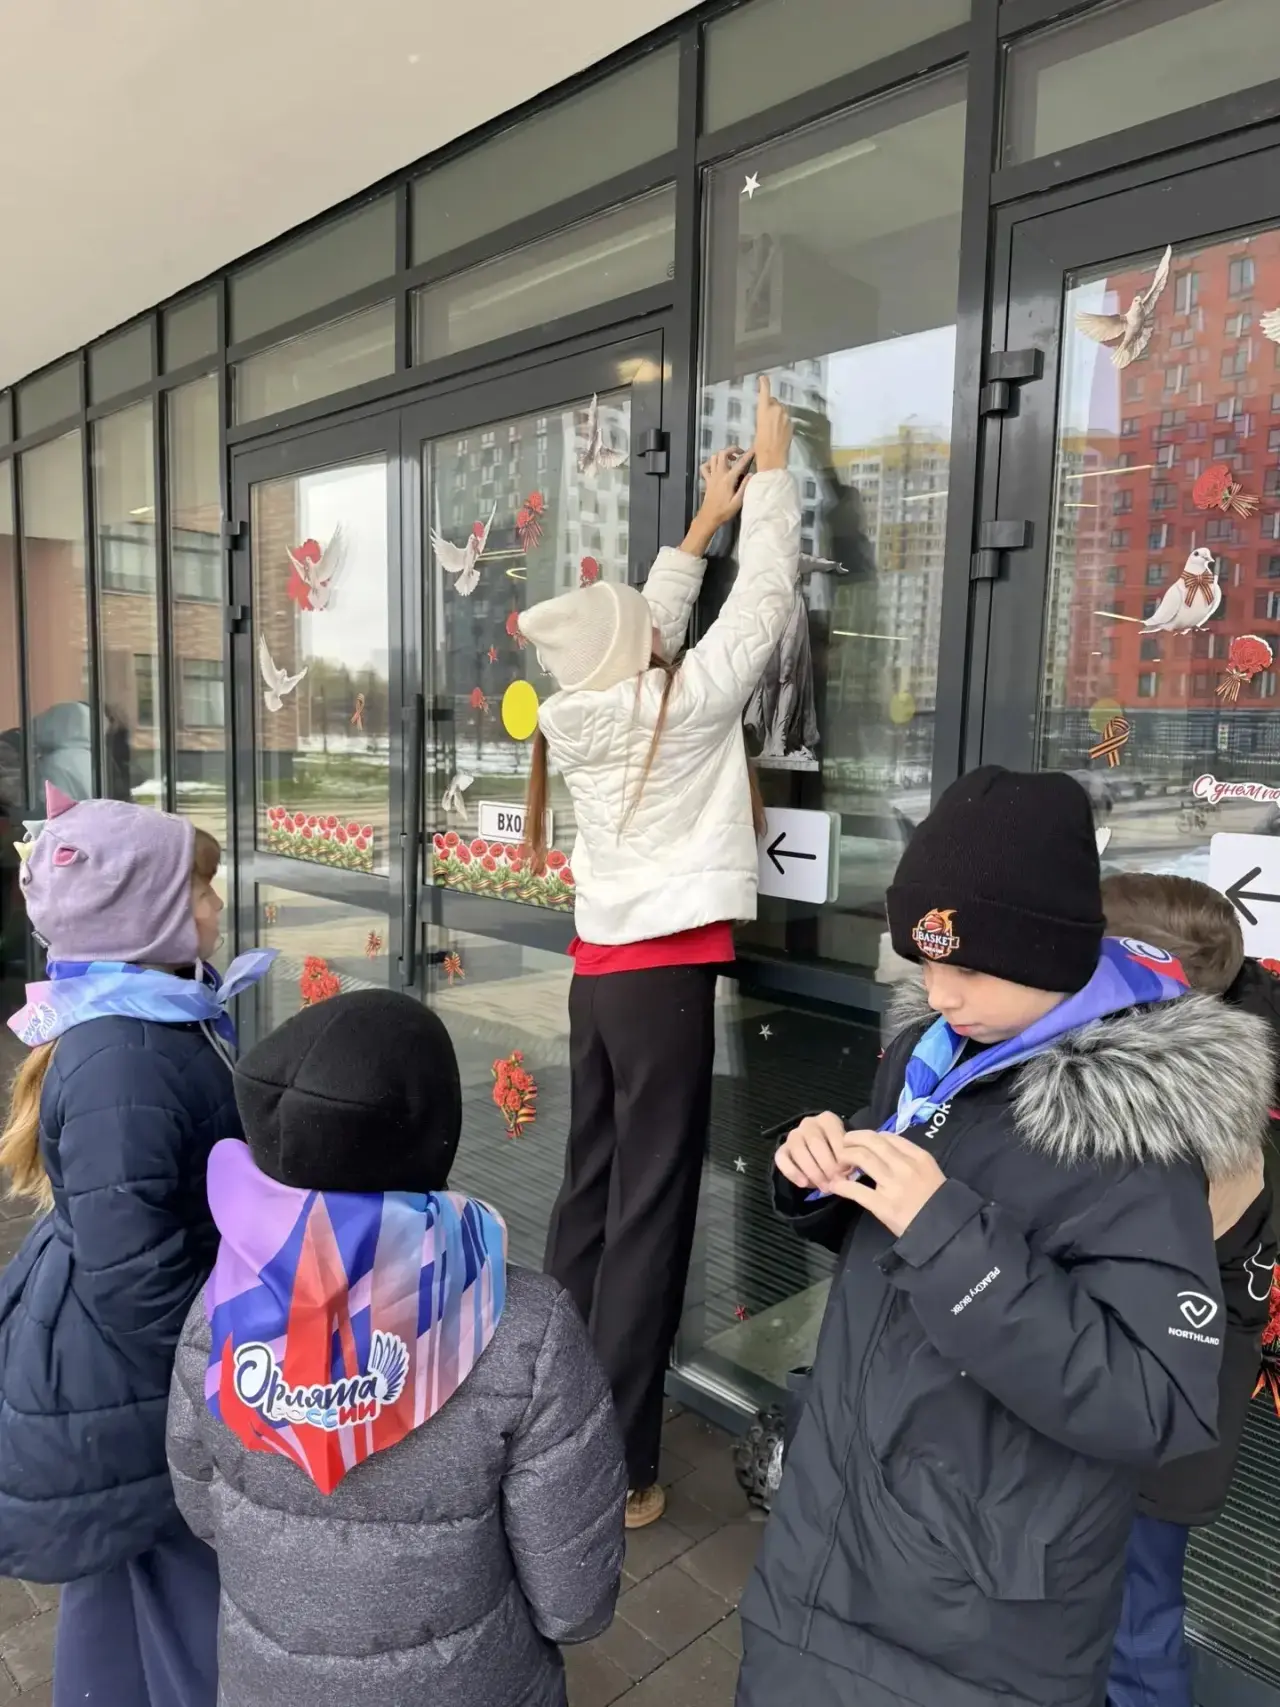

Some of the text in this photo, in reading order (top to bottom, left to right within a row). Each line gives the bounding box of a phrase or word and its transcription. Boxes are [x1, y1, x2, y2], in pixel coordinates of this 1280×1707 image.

[497, 813, 526, 833] ВХО
[1168, 1326, 1220, 1346] NORTHLAND
[236, 1344, 378, 1413] Орлята
